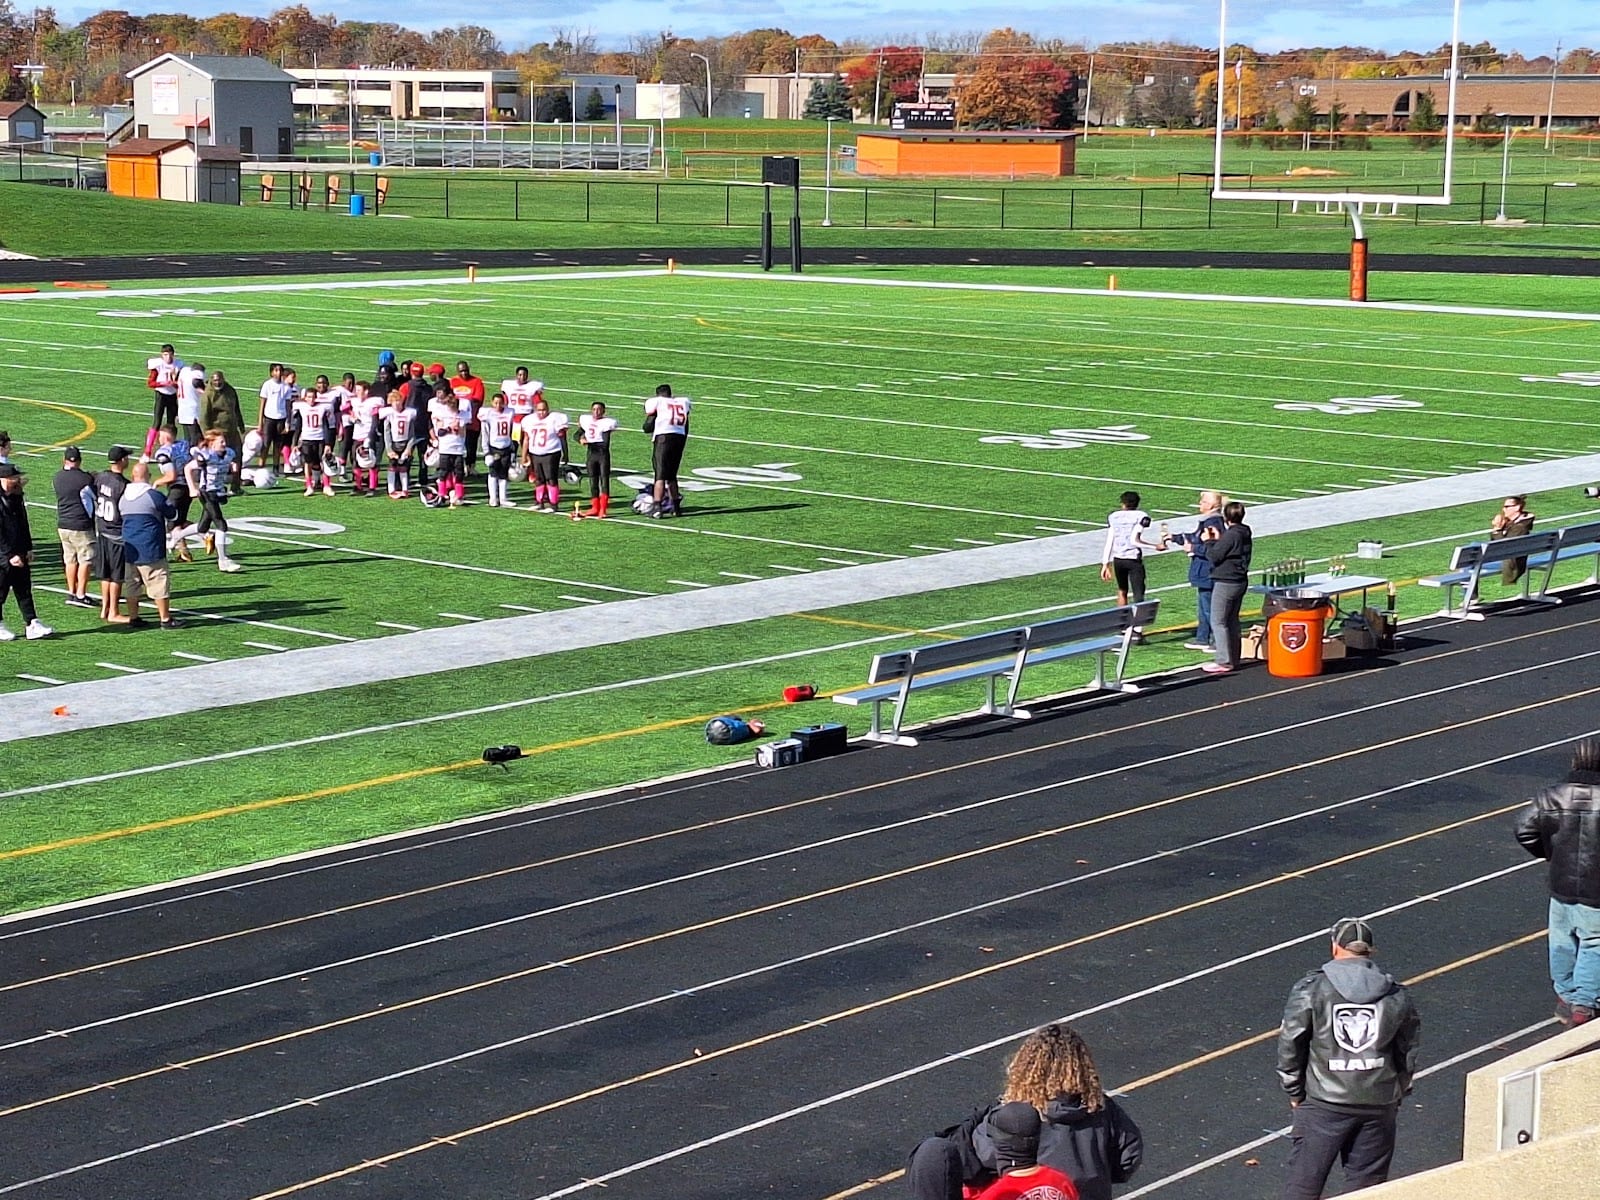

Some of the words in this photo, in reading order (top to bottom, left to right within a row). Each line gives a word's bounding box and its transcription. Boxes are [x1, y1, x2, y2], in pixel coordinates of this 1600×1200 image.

[307, 413, 319, 428] 10
[667, 404, 686, 426] 75
[397, 420, 405, 435] 9
[497, 421, 508, 436] 18
[531, 428, 548, 447] 73
[1328, 1057, 1385, 1071] RAM
